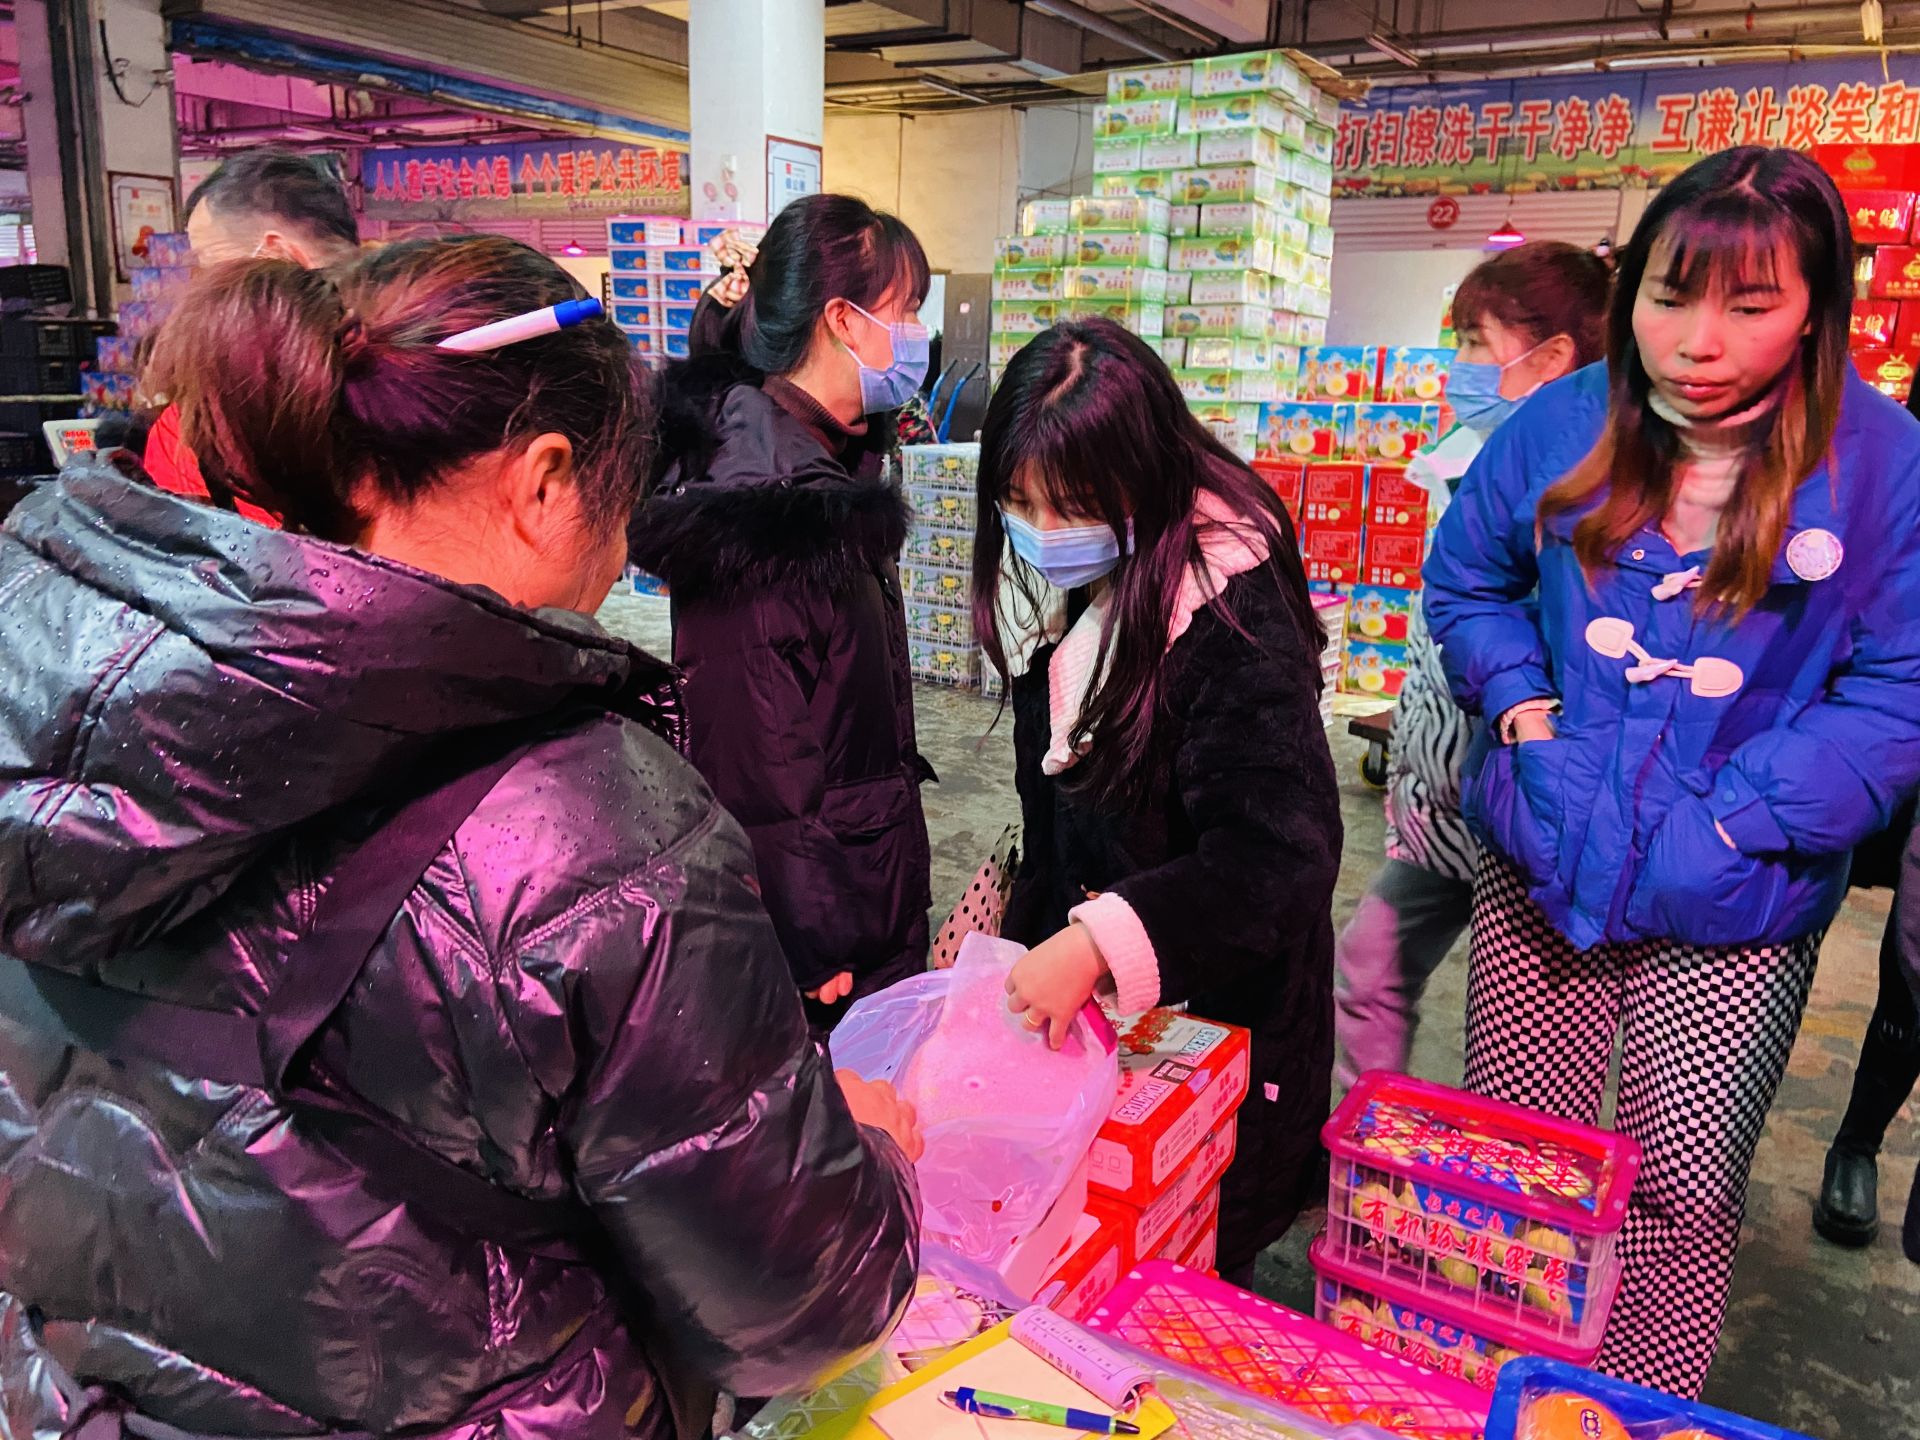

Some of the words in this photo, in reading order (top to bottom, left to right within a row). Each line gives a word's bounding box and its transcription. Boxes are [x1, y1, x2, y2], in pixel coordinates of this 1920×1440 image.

[1335, 93, 1633, 170] 打扫擦洗干干净净
[520, 147, 682, 200] 个个爱护公共环境
[1432, 205, 1455, 222] 22
